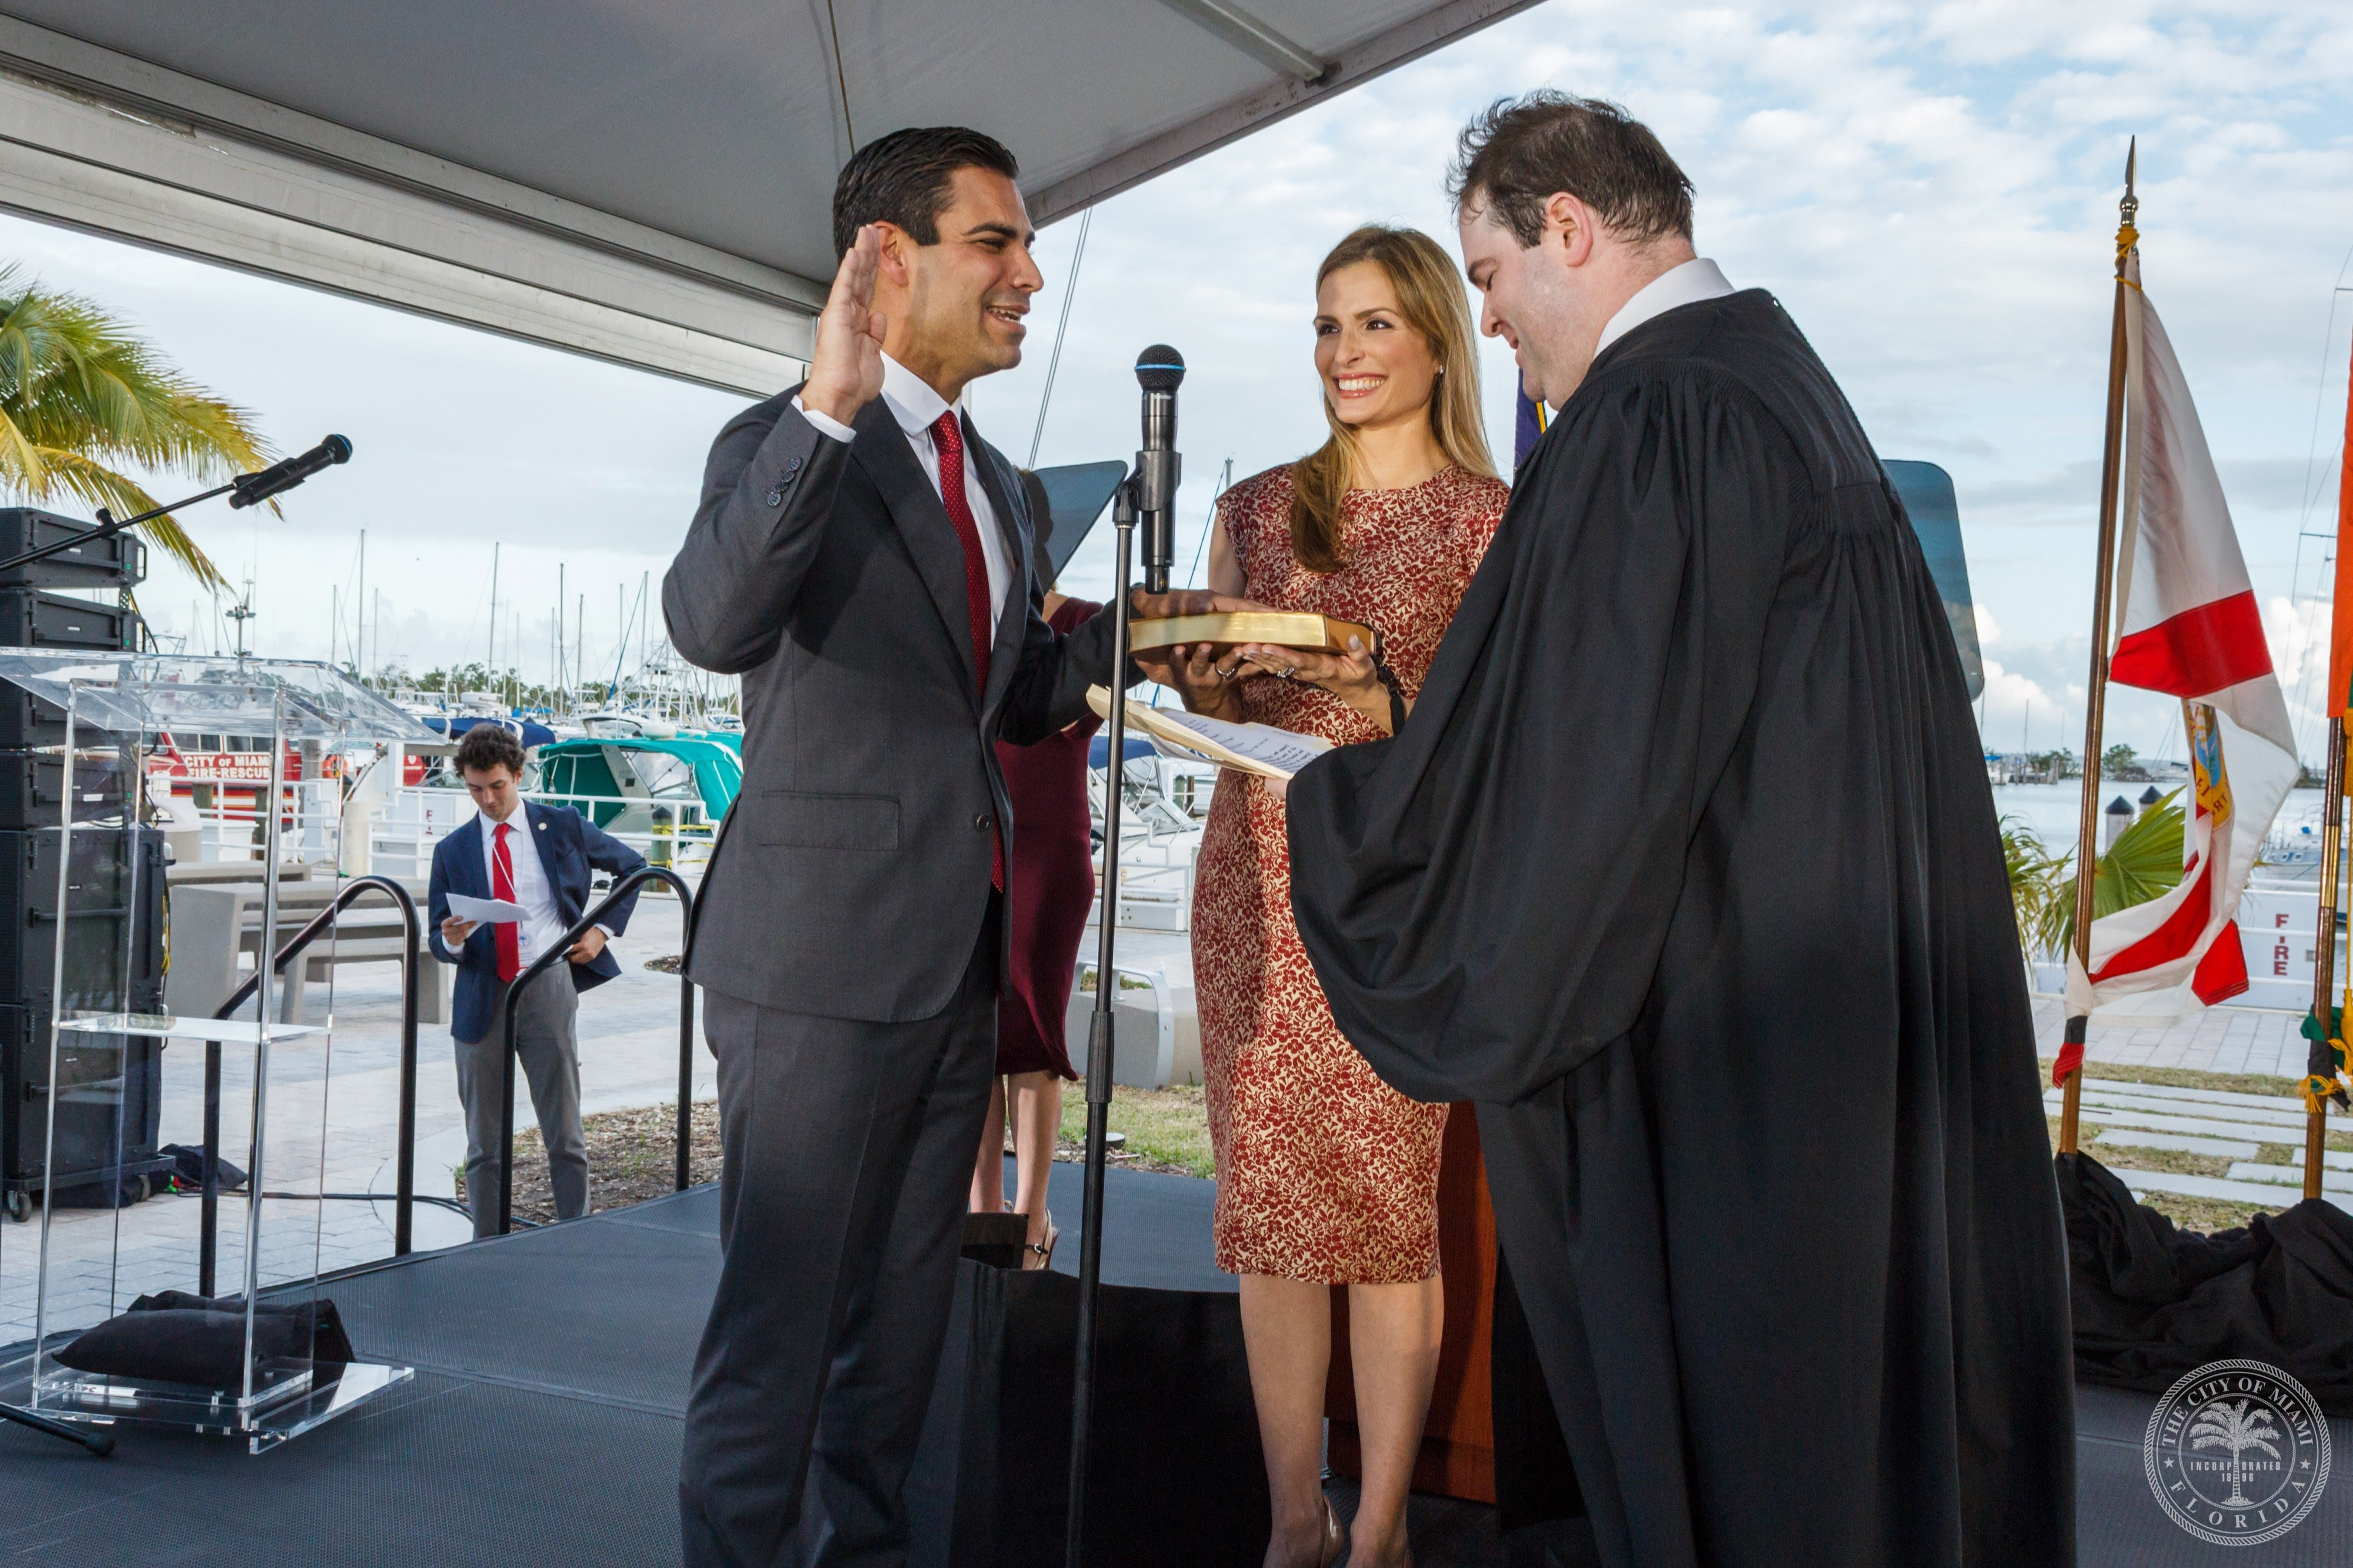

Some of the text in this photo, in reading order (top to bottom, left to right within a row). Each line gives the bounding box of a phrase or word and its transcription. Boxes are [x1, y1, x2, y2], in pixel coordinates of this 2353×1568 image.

[184, 756, 270, 766] CITY OF MIAM
